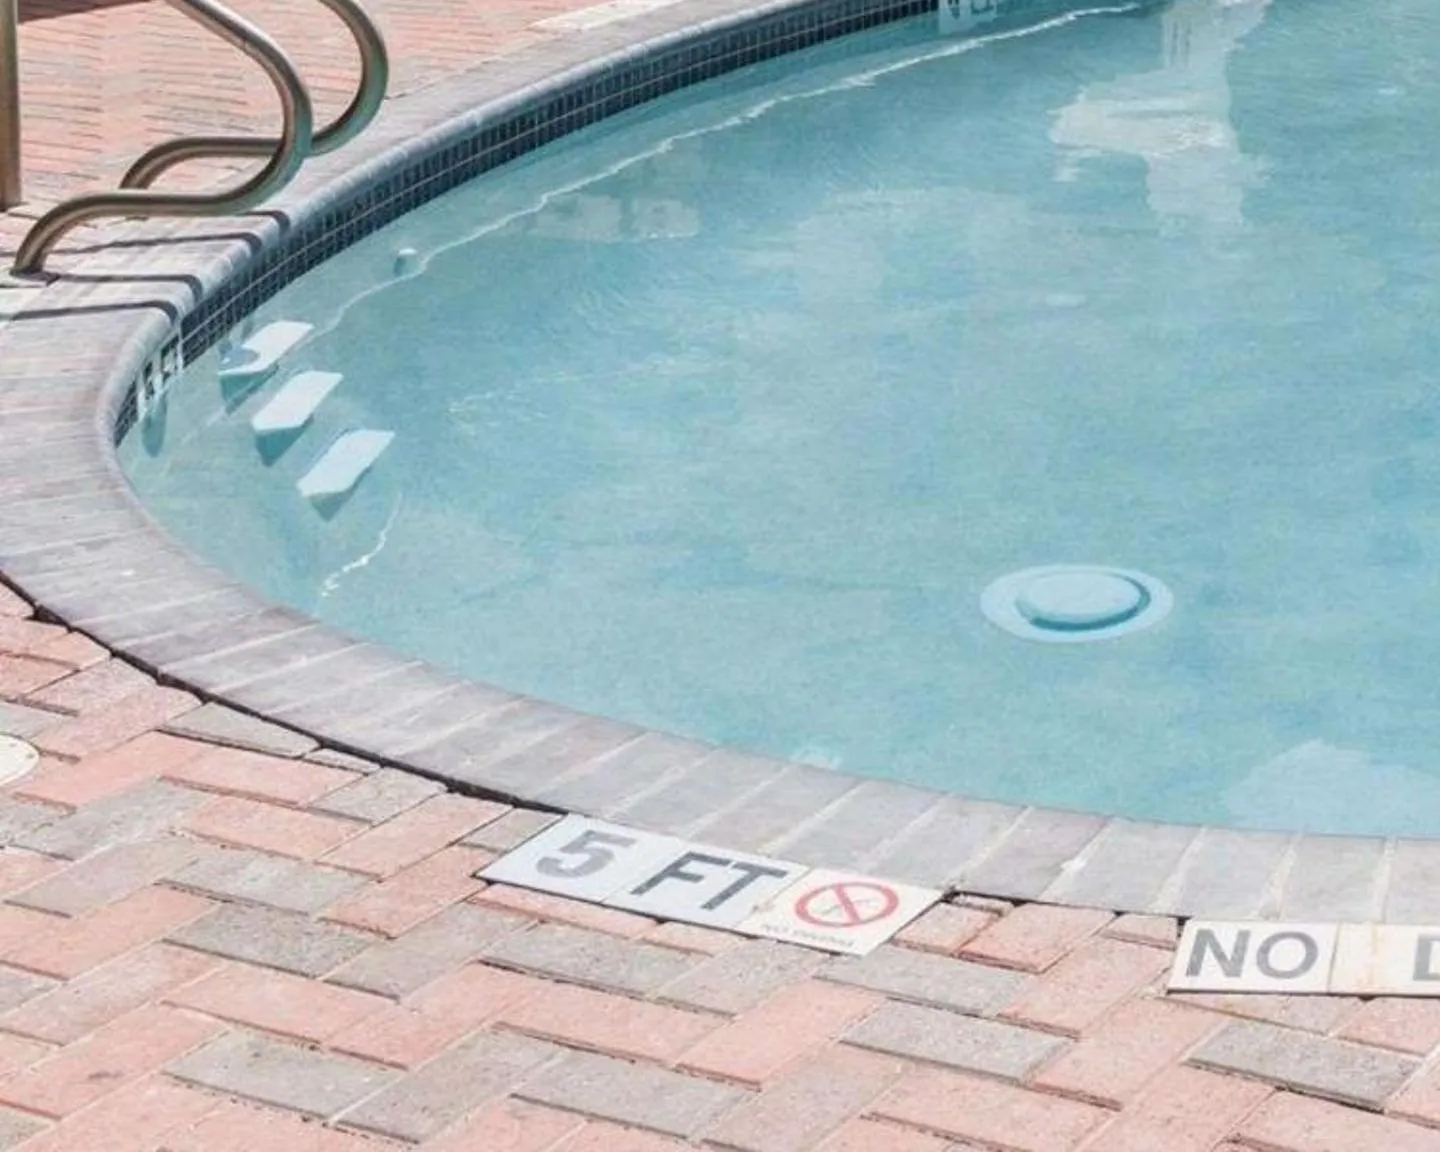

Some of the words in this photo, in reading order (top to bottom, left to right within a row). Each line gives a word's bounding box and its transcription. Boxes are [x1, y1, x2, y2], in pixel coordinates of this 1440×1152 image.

[536, 829, 637, 880] 5
[630, 850, 790, 911] FT
[1185, 928, 1319, 980] NO
